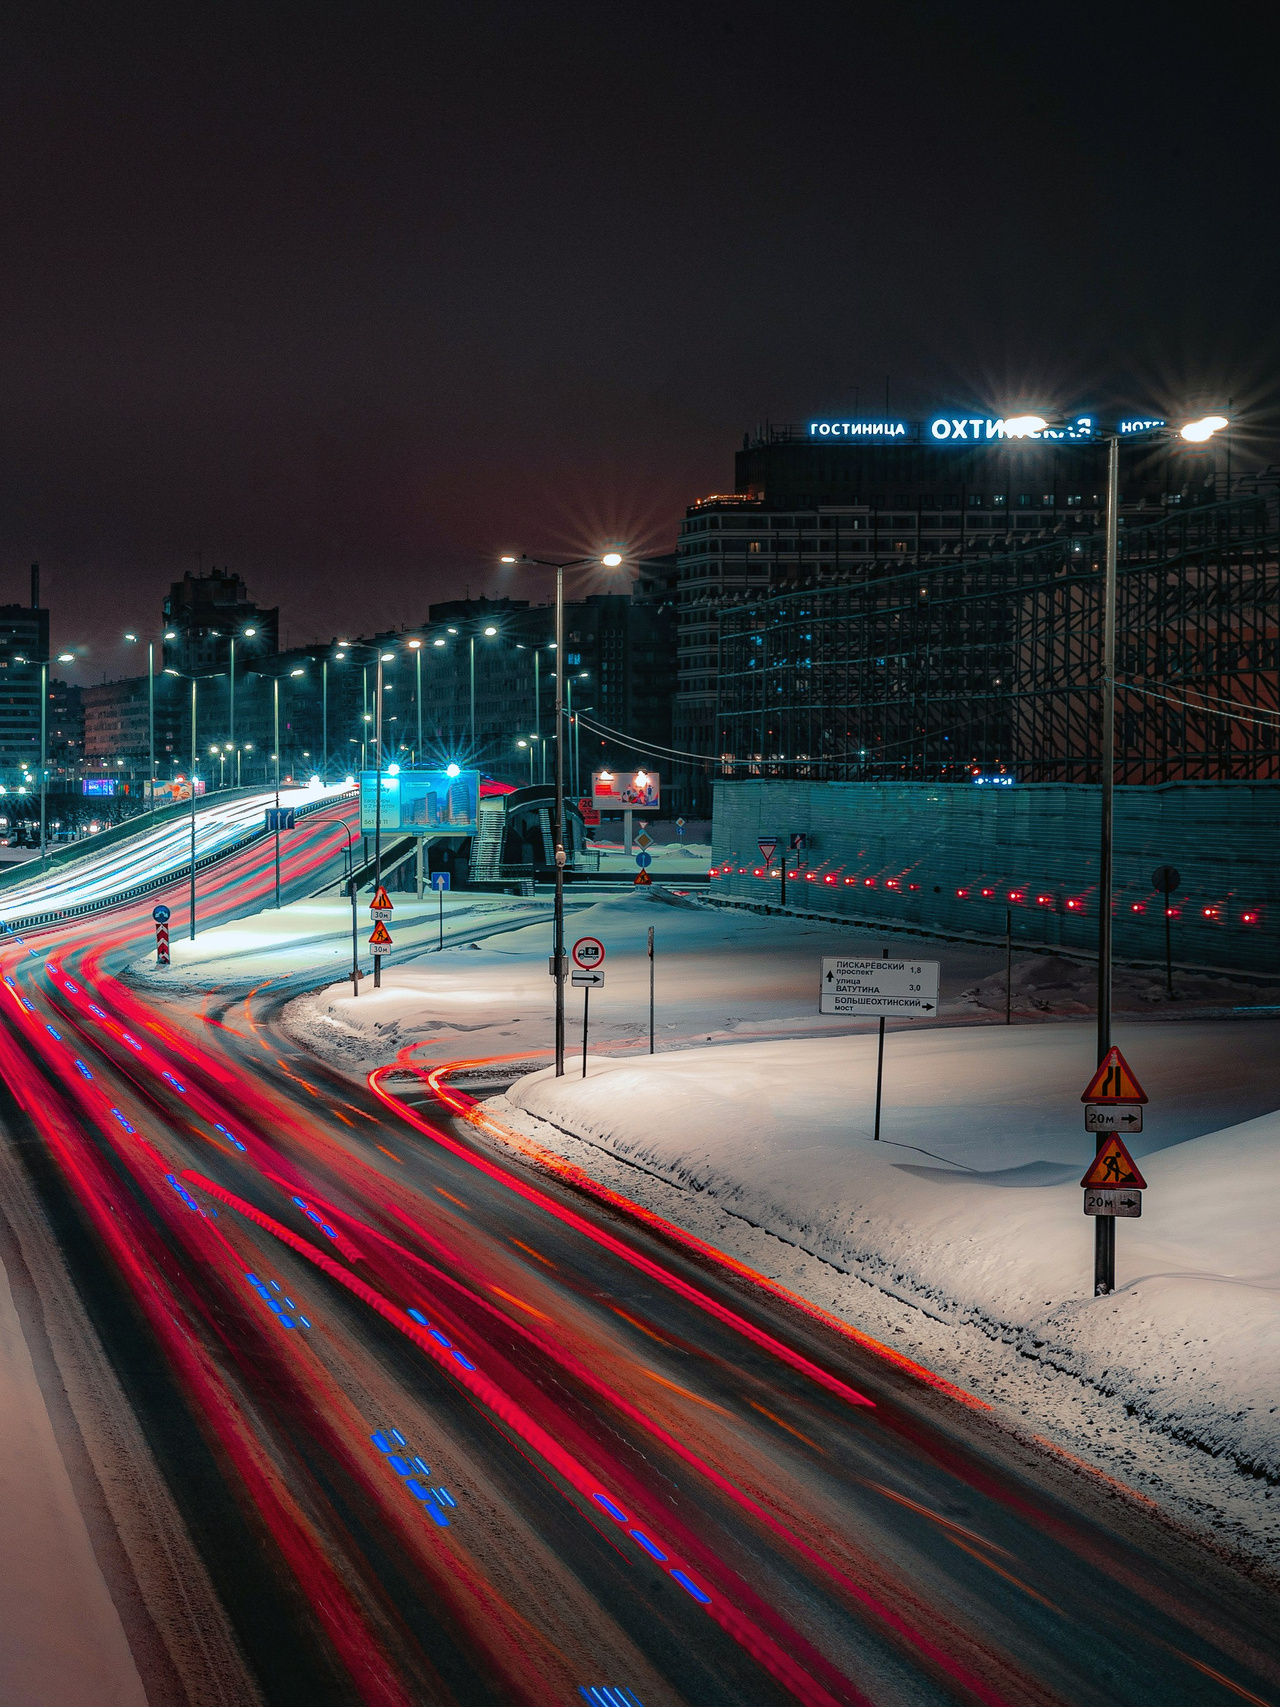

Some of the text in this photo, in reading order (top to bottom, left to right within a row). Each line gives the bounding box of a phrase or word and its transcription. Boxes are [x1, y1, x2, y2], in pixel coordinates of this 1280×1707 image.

[811, 423, 905, 437] ГОСТИНИЦА
[836, 961, 905, 970] ПИСКАРЁВСКИЙ
[910, 966, 922, 974] 1,8
[836, 985, 880, 993] ВАТУТИНА
[909, 984, 921, 992] 3,0
[835, 996, 921, 1007] БОЛЬШЕОХТИНСКИЙ
[1089, 1113, 1114, 1124] 20м
[1088, 1196, 1113, 1207] 20м
